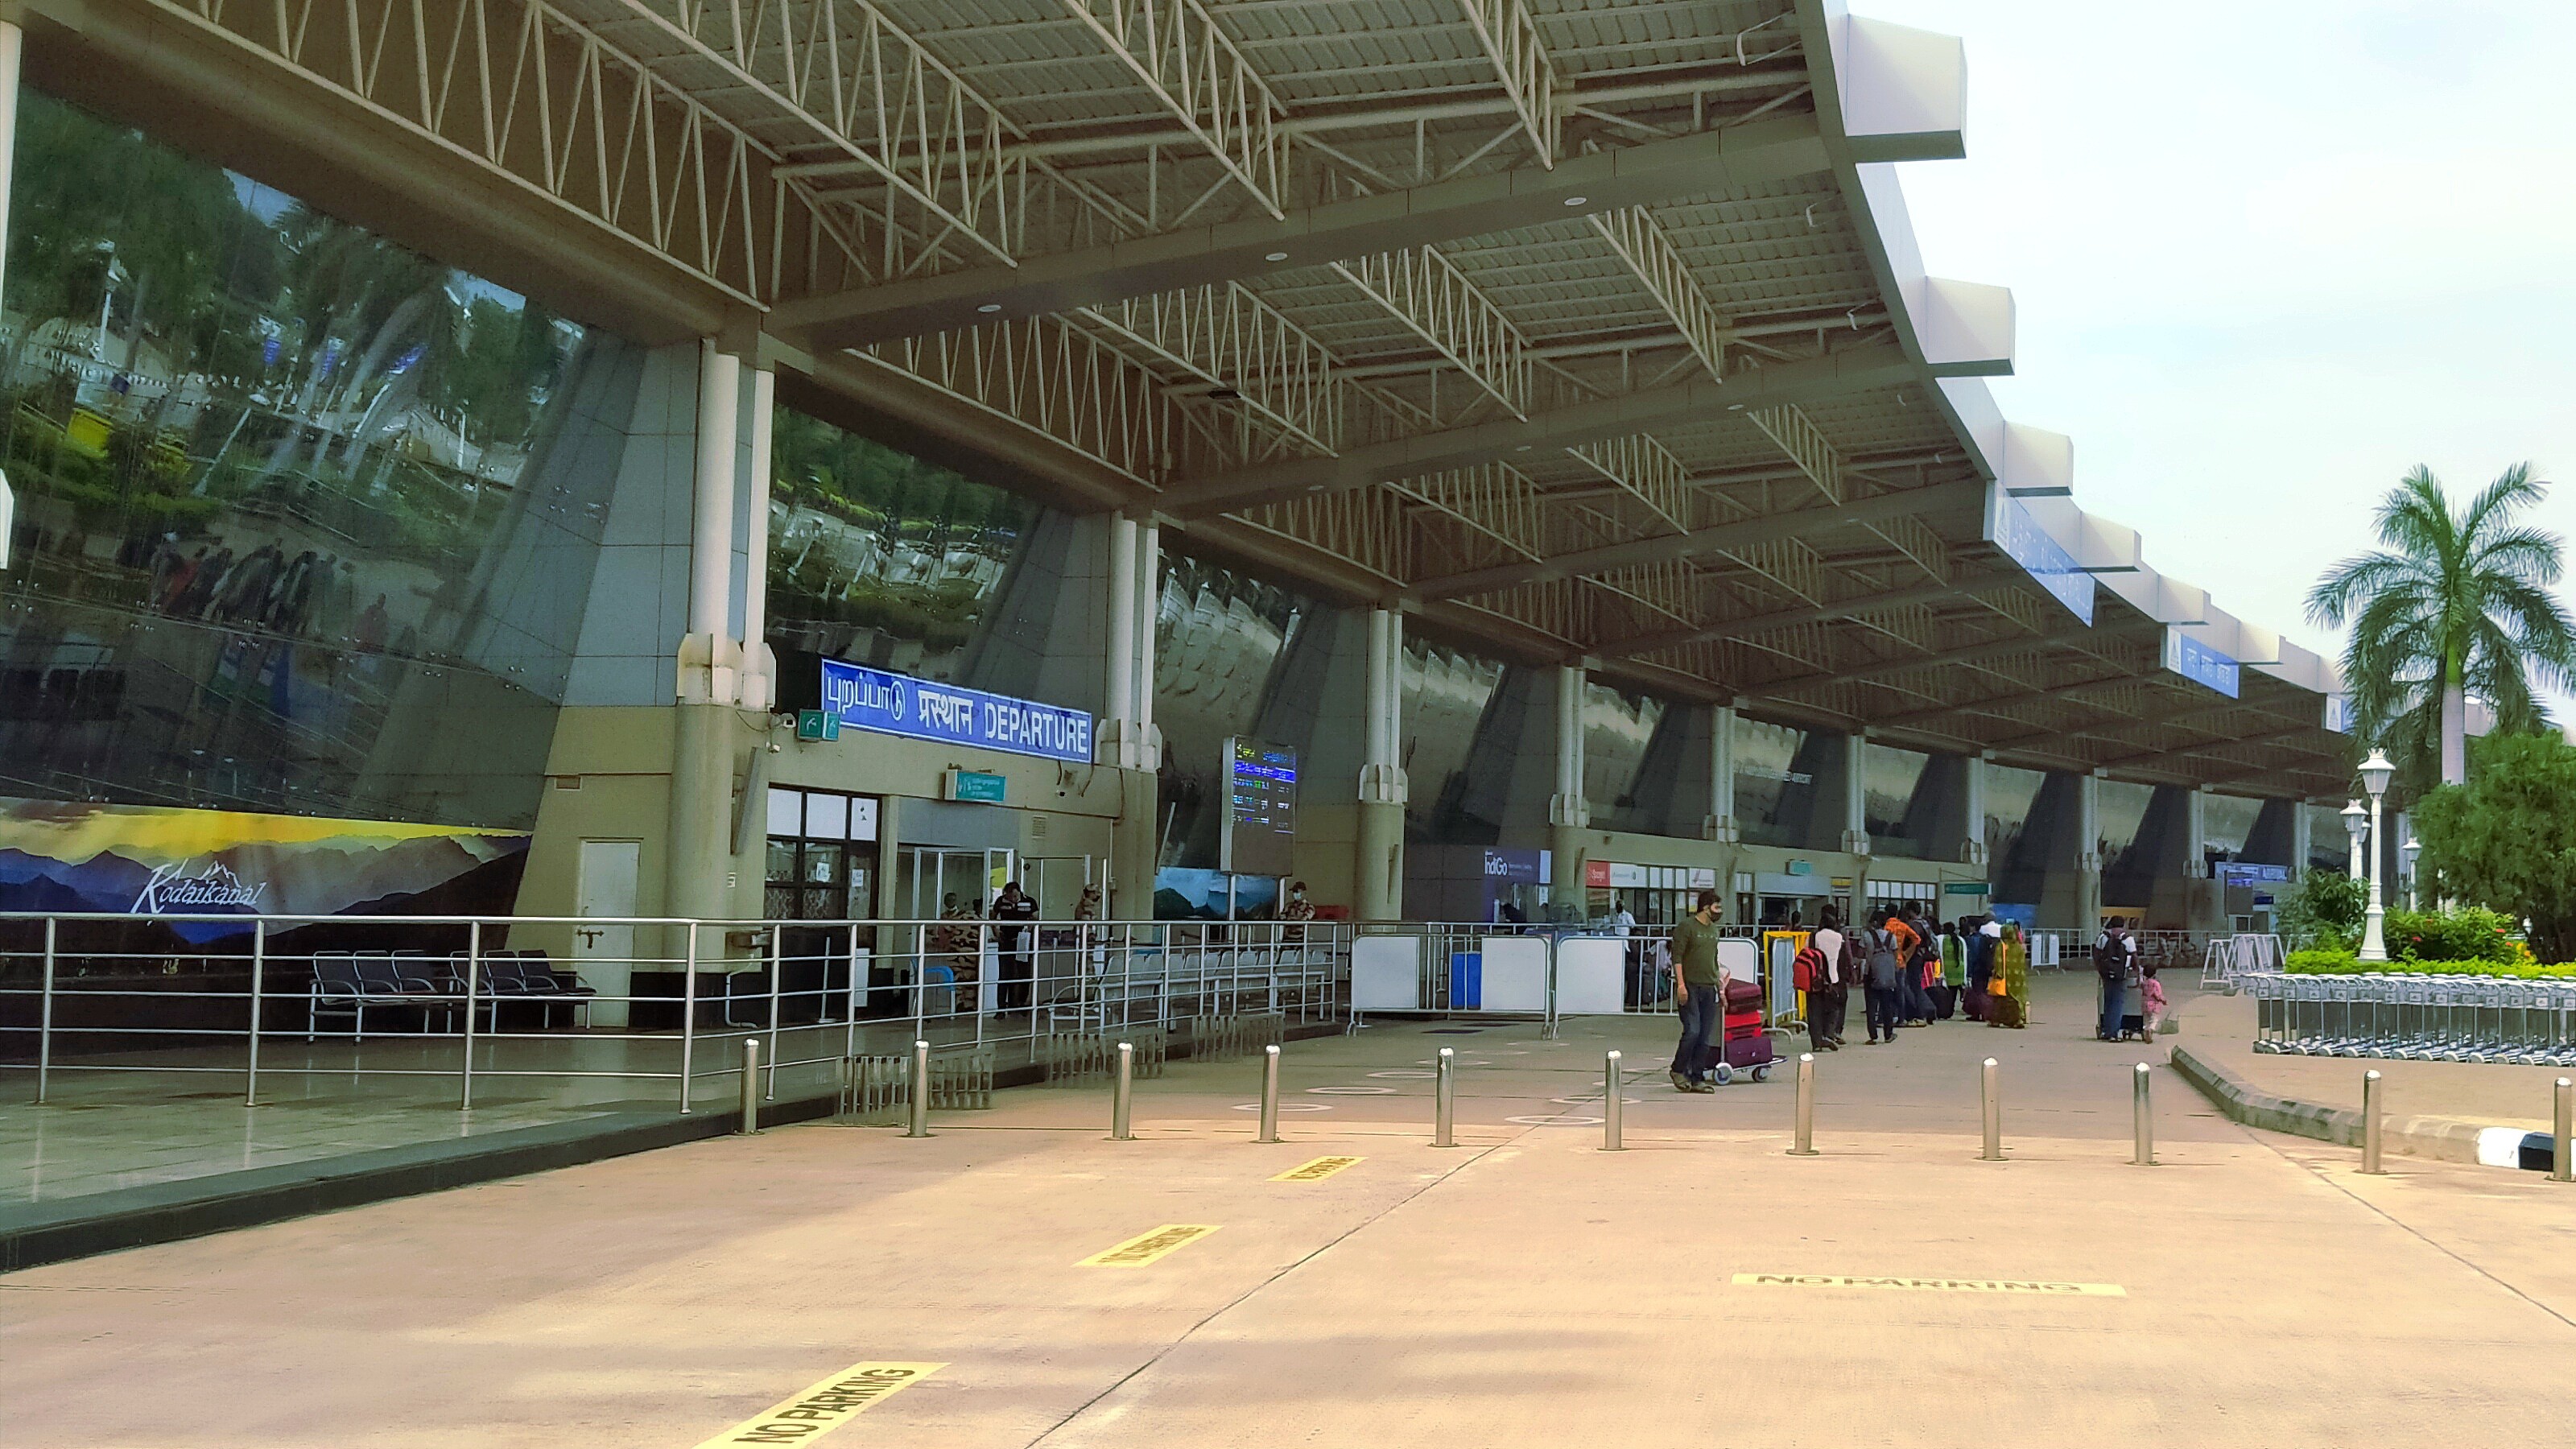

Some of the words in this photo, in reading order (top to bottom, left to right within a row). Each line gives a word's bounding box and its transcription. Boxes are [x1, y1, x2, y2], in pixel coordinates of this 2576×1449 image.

[918, 690, 973, 735] प्रस्थान
[985, 702, 1087, 753] DEPARTURE
[130, 857, 267, 914] Kodaikanal
[1757, 1275, 1831, 1285] NO
[1843, 1278, 2082, 1292] PARKING
[775, 1368, 916, 1420] PARKING
[732, 1422, 819, 1443] NO
